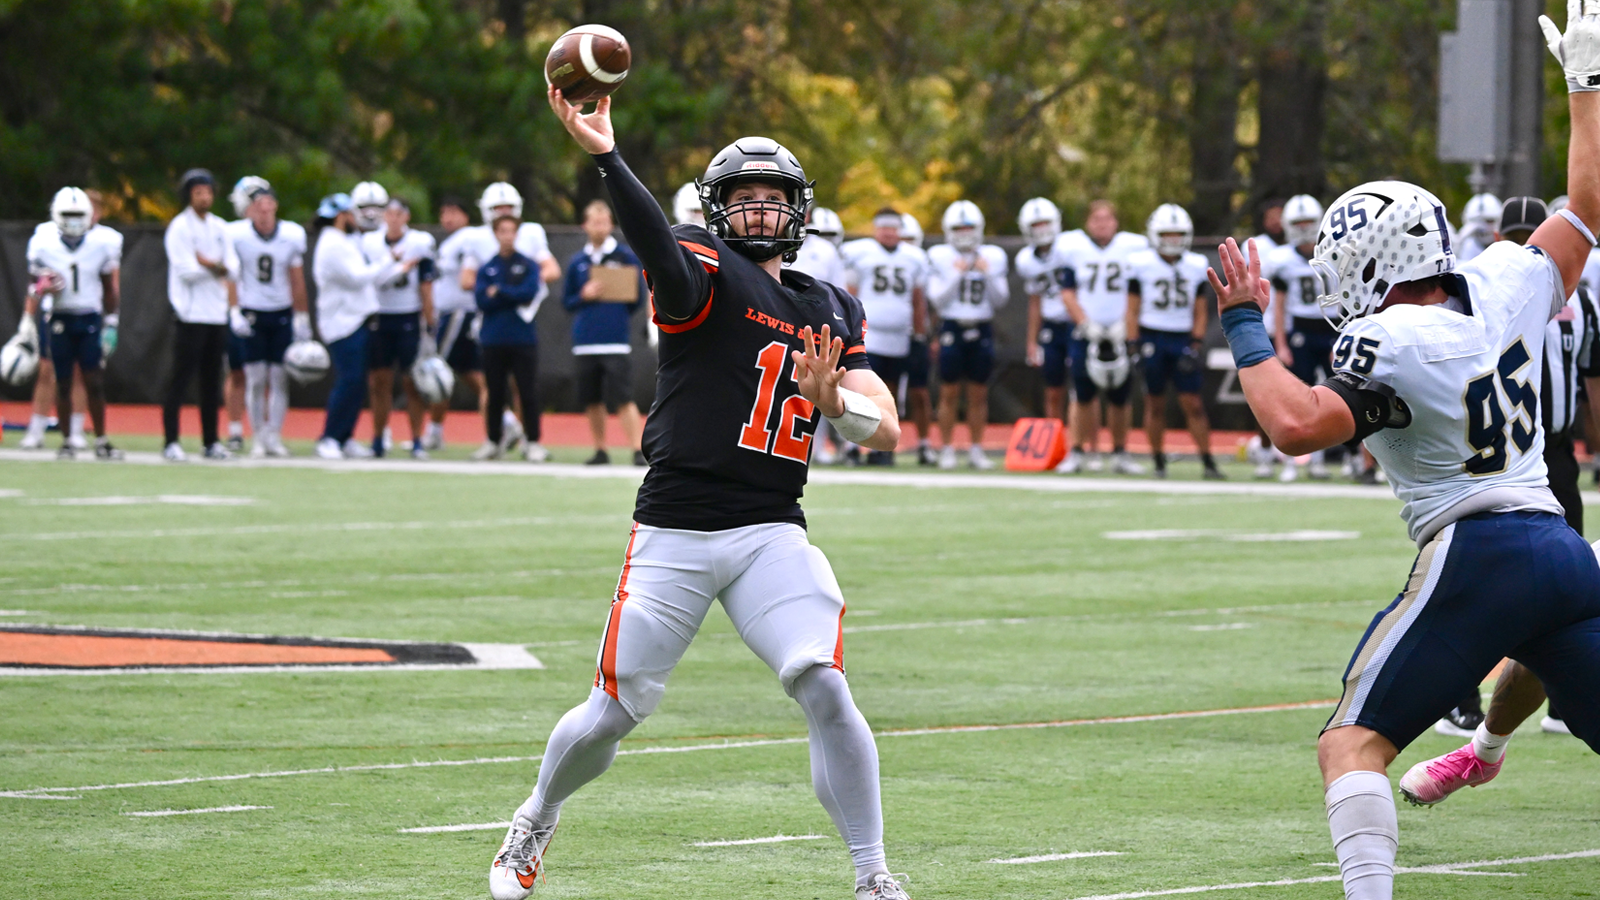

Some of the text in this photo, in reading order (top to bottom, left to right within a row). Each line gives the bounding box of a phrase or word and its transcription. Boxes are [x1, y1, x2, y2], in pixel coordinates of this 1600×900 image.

[1329, 197, 1369, 241] 95
[70, 263, 80, 293] 1
[258, 255, 274, 284] 9
[873, 265, 907, 295] 55
[1086, 262, 1122, 293] 72
[1154, 278, 1189, 309] 35
[745, 307, 795, 336] LEWIS
[1333, 334, 1382, 377] 95
[1562, 333, 1574, 352] U
[737, 340, 815, 466] 12
[1460, 333, 1538, 478] 95
[1015, 421, 1055, 460] 40
